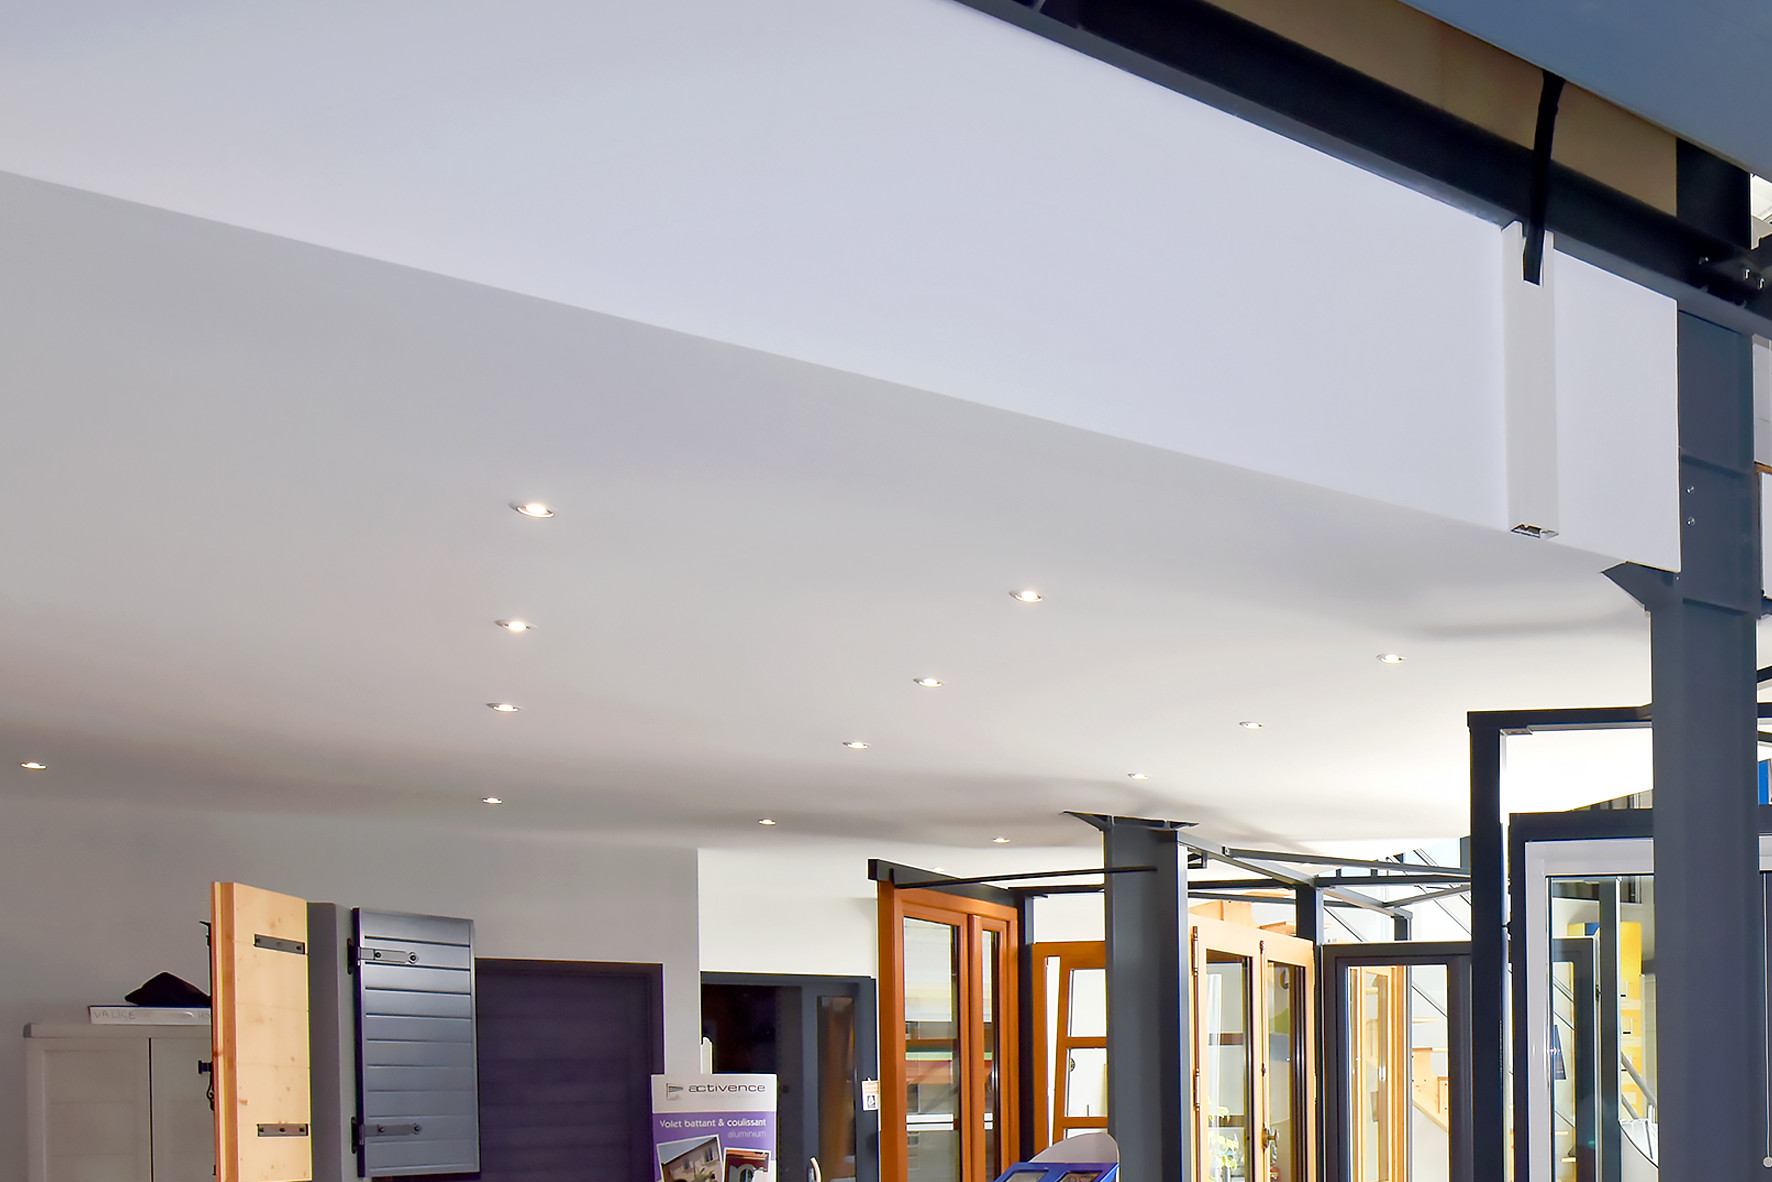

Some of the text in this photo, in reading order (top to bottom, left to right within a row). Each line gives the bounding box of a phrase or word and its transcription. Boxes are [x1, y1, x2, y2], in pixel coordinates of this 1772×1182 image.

[688, 1084, 766, 1093] activence
[660, 1118, 767, 1129] Volet battant & coulissant
[728, 1130, 767, 1139] aluminium
